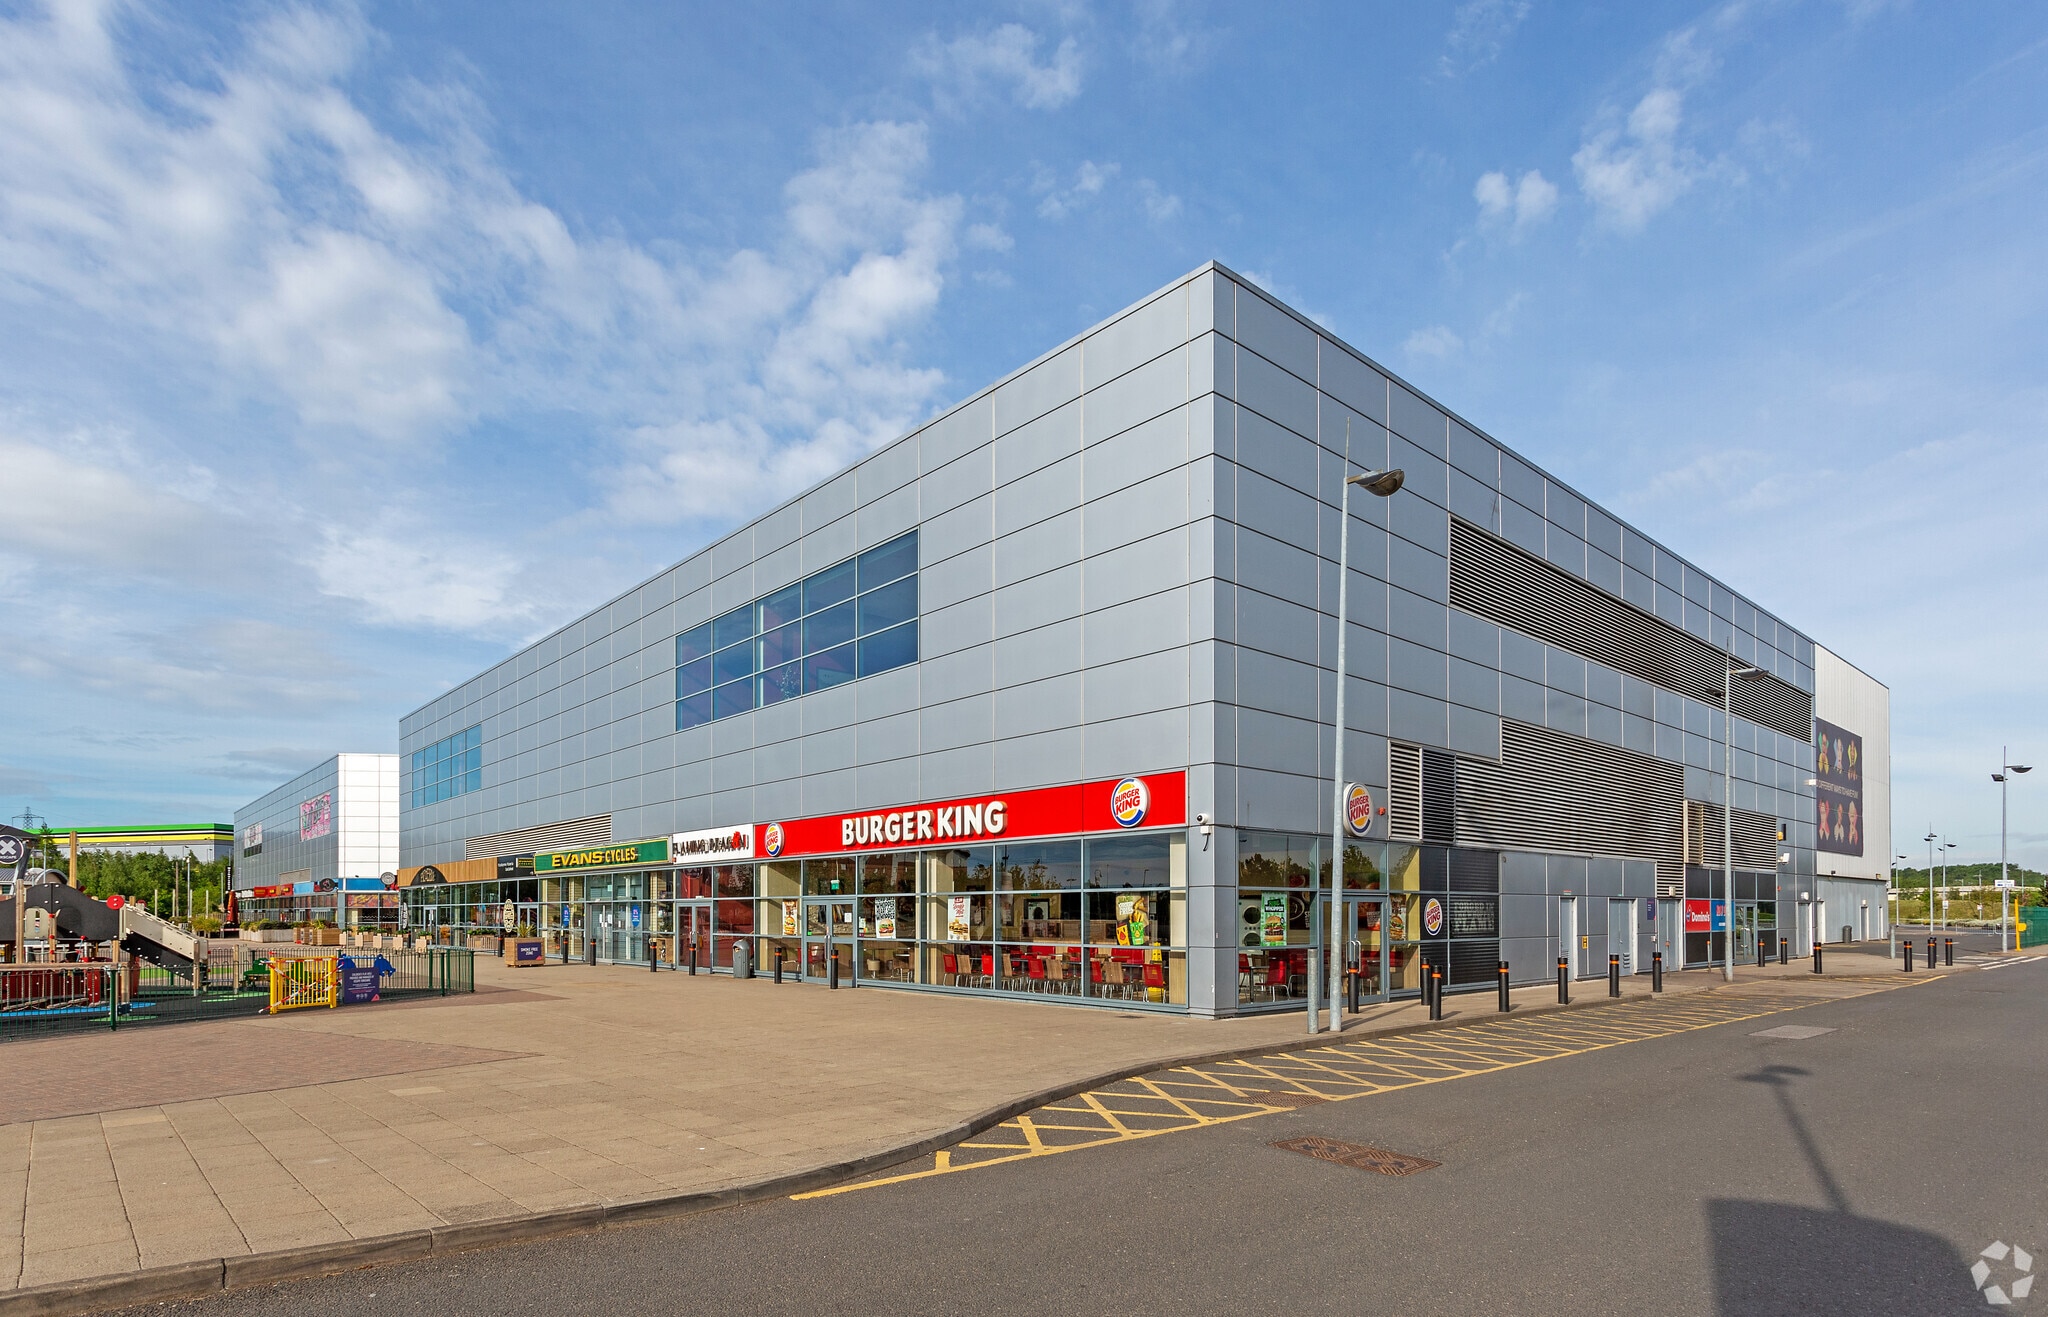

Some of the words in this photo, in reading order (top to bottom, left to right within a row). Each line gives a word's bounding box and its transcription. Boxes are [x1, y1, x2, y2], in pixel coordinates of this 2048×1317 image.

[1115, 788, 1140, 805] BURGER
[1116, 795, 1140, 815] KING
[1350, 796, 1369, 809] BURGER
[1350, 803, 1370, 822] KING
[842, 809, 935, 846] BURGER
[937, 801, 1006, 838] KING
[767, 835, 778, 847] KING
[552, 851, 603, 867] EVANS
[605, 847, 637, 863] CYCLES
[1427, 905, 1440, 918] BURGER
[1427, 911, 1440, 927] KING
